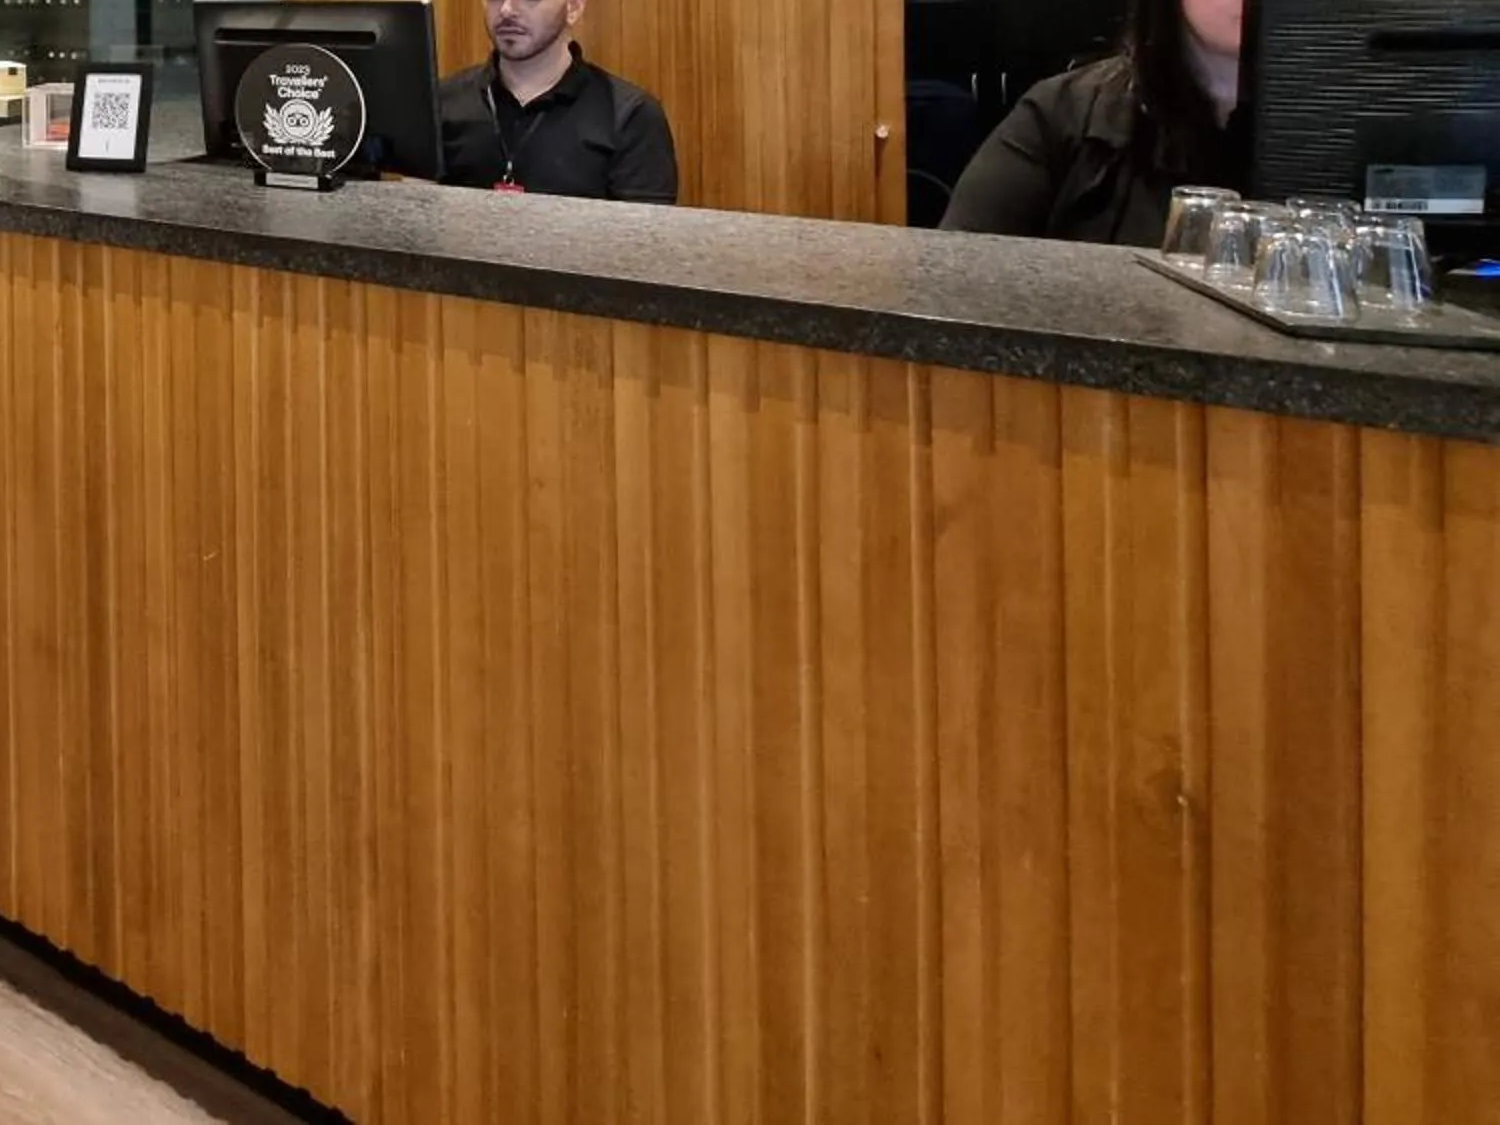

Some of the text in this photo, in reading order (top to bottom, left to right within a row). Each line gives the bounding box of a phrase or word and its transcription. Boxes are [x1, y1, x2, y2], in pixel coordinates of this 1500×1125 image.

[262, 144, 336, 159] Best of the Best
